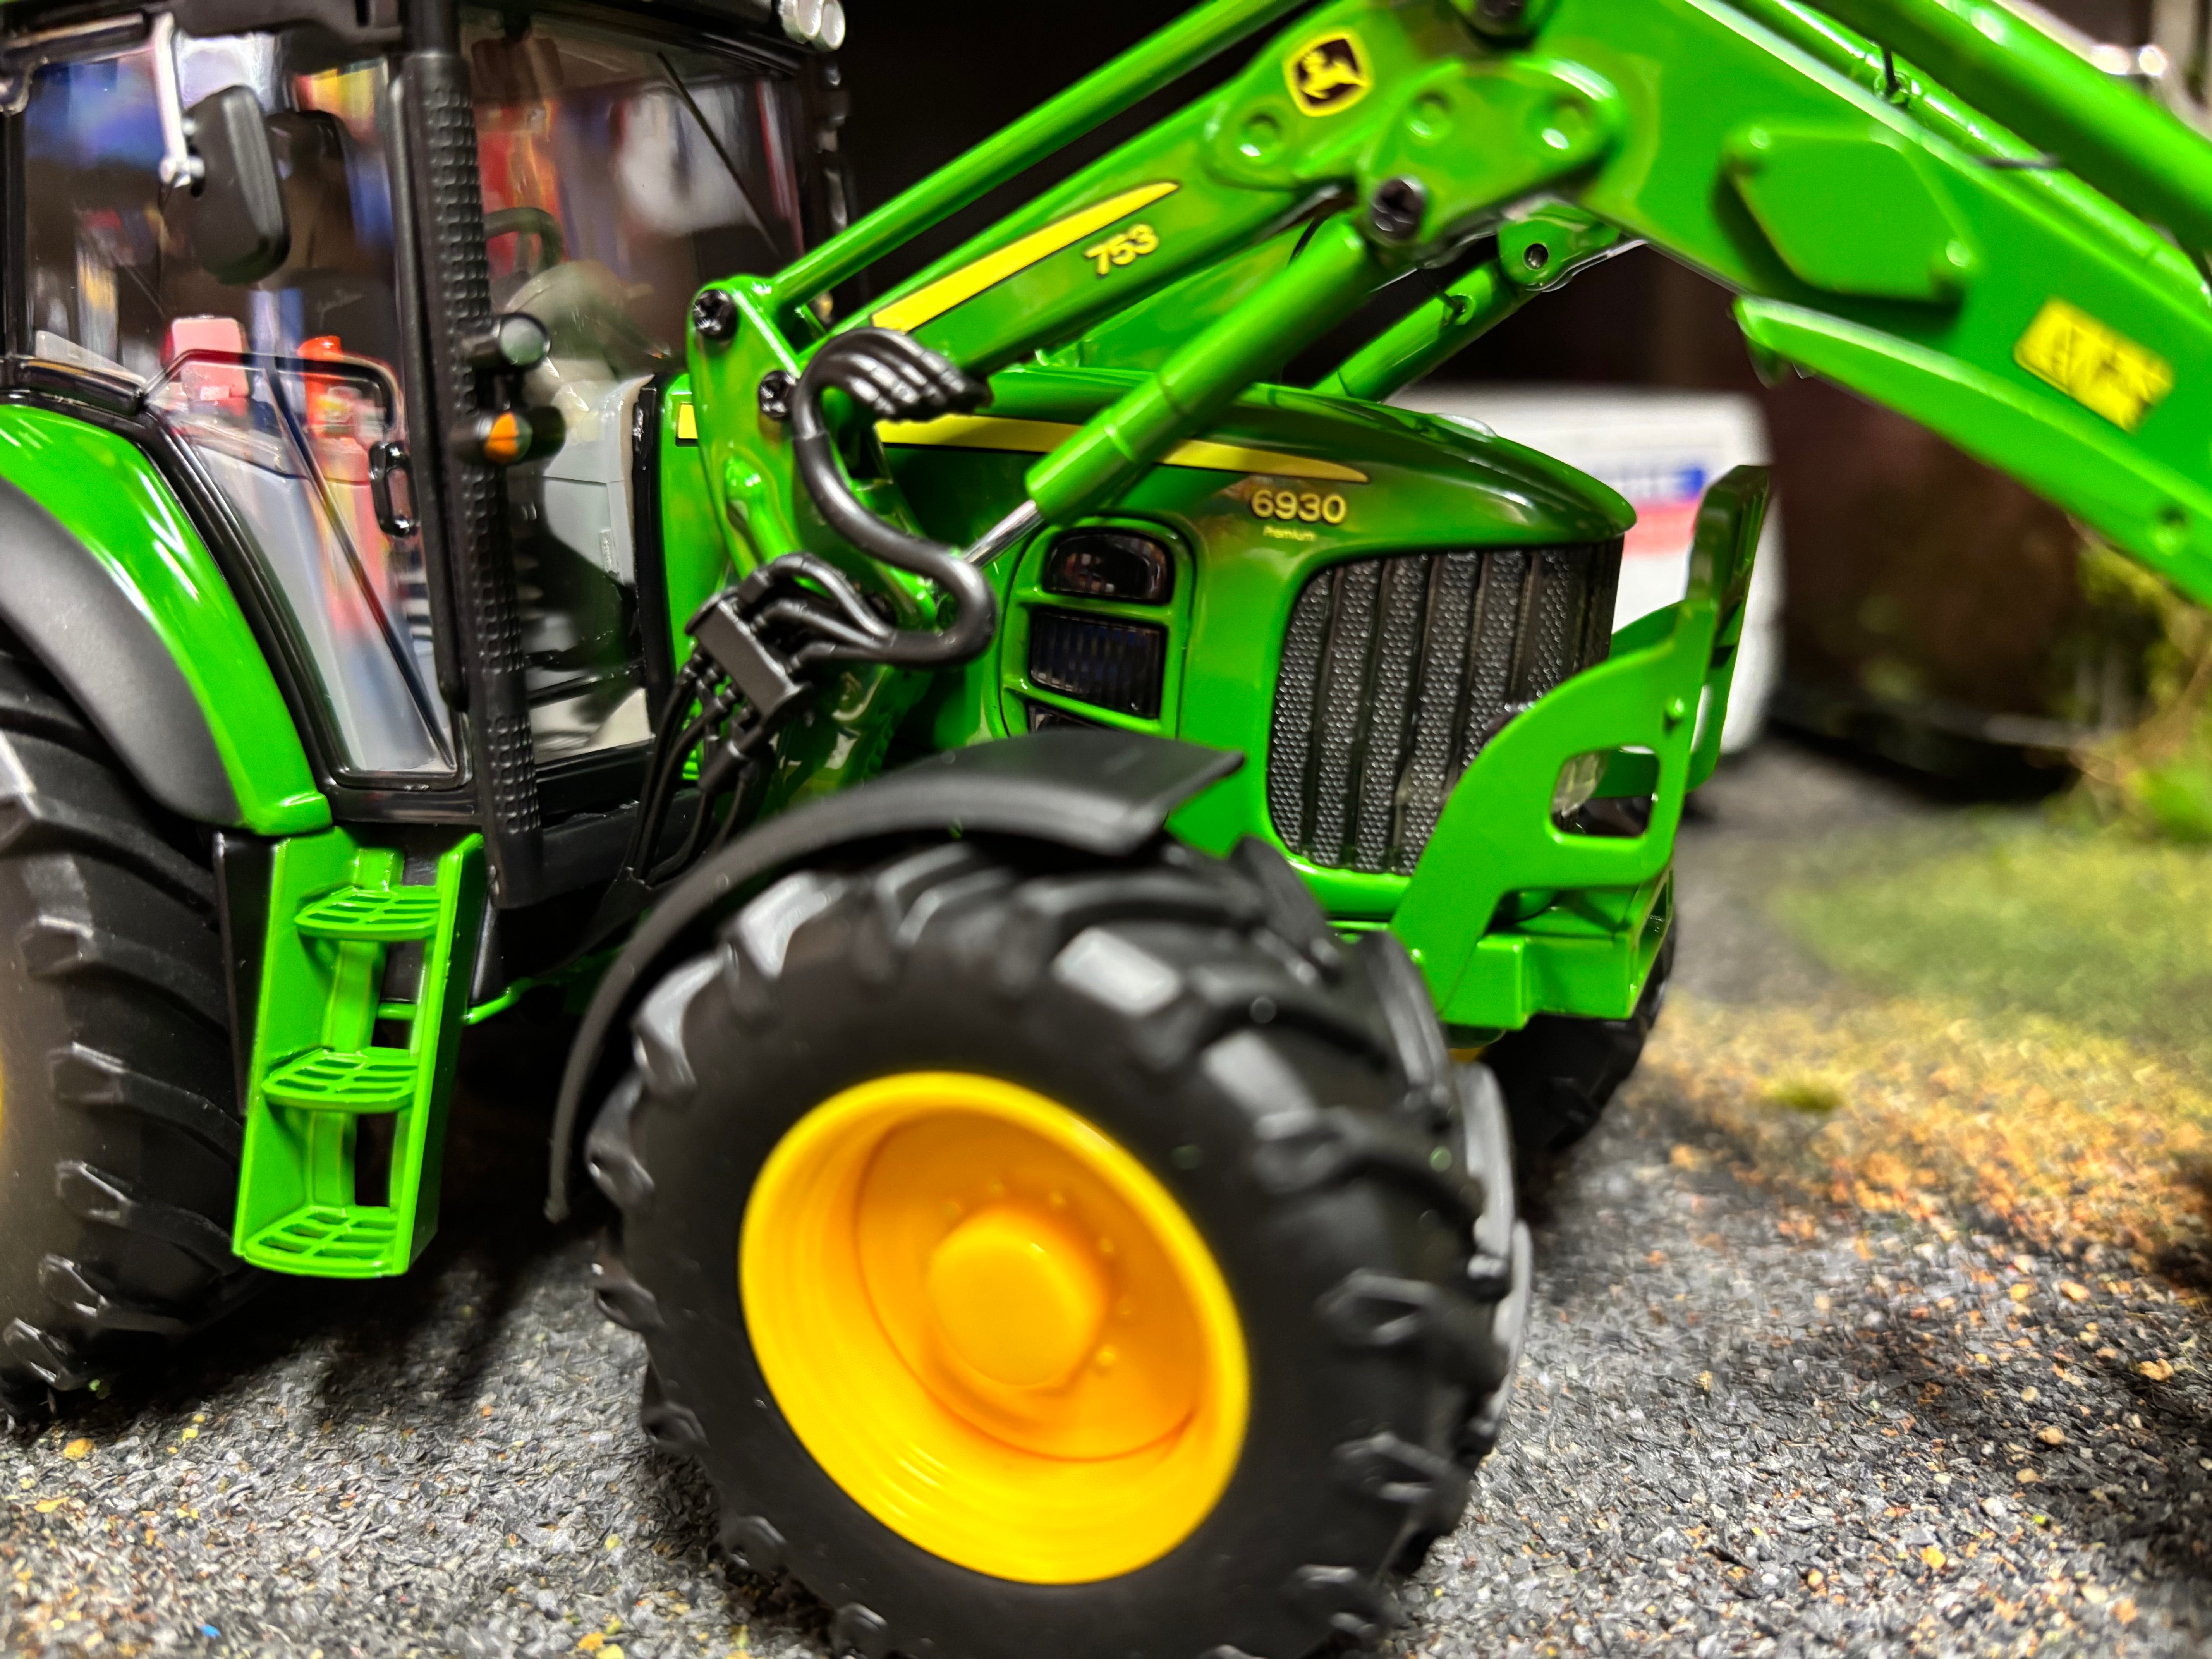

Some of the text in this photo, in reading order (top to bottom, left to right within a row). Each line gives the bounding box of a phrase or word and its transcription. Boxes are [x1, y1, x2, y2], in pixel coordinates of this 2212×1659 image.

[1085, 223, 1159, 275] 753
[1252, 489, 1347, 524] 6930
[1263, 525, 1316, 541] Premium
